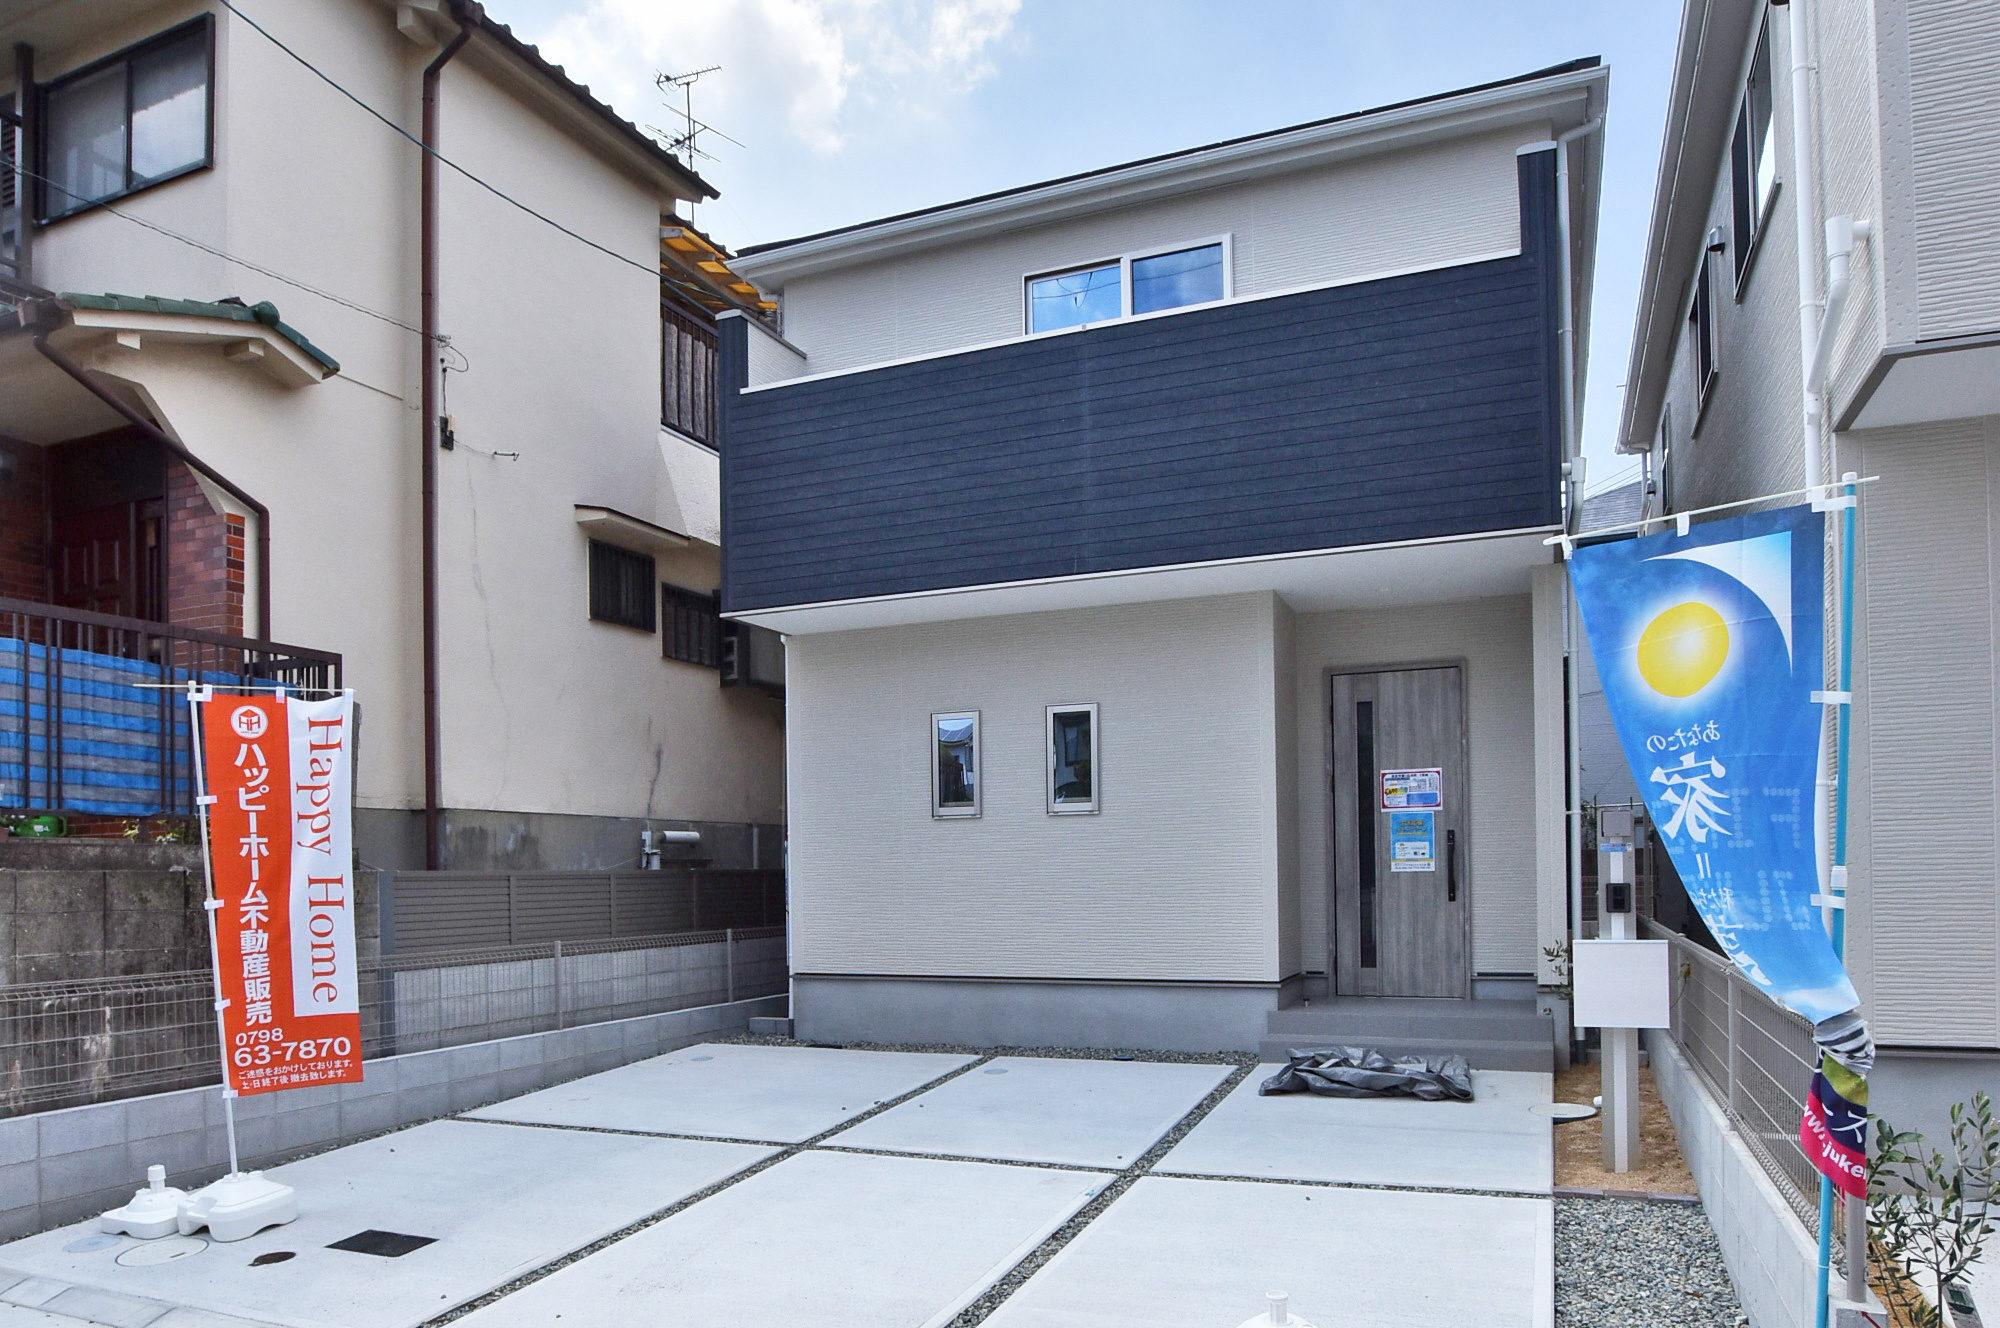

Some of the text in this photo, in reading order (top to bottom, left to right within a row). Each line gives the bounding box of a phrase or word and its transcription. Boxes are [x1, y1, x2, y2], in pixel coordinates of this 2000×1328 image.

[234, 742, 273, 1028] ハッピーホーム不動産販売
[296, 714, 346, 1004] Happy Home
[234, 1037, 351, 1067] 63-7870
[235, 1028, 284, 1046] 0798
